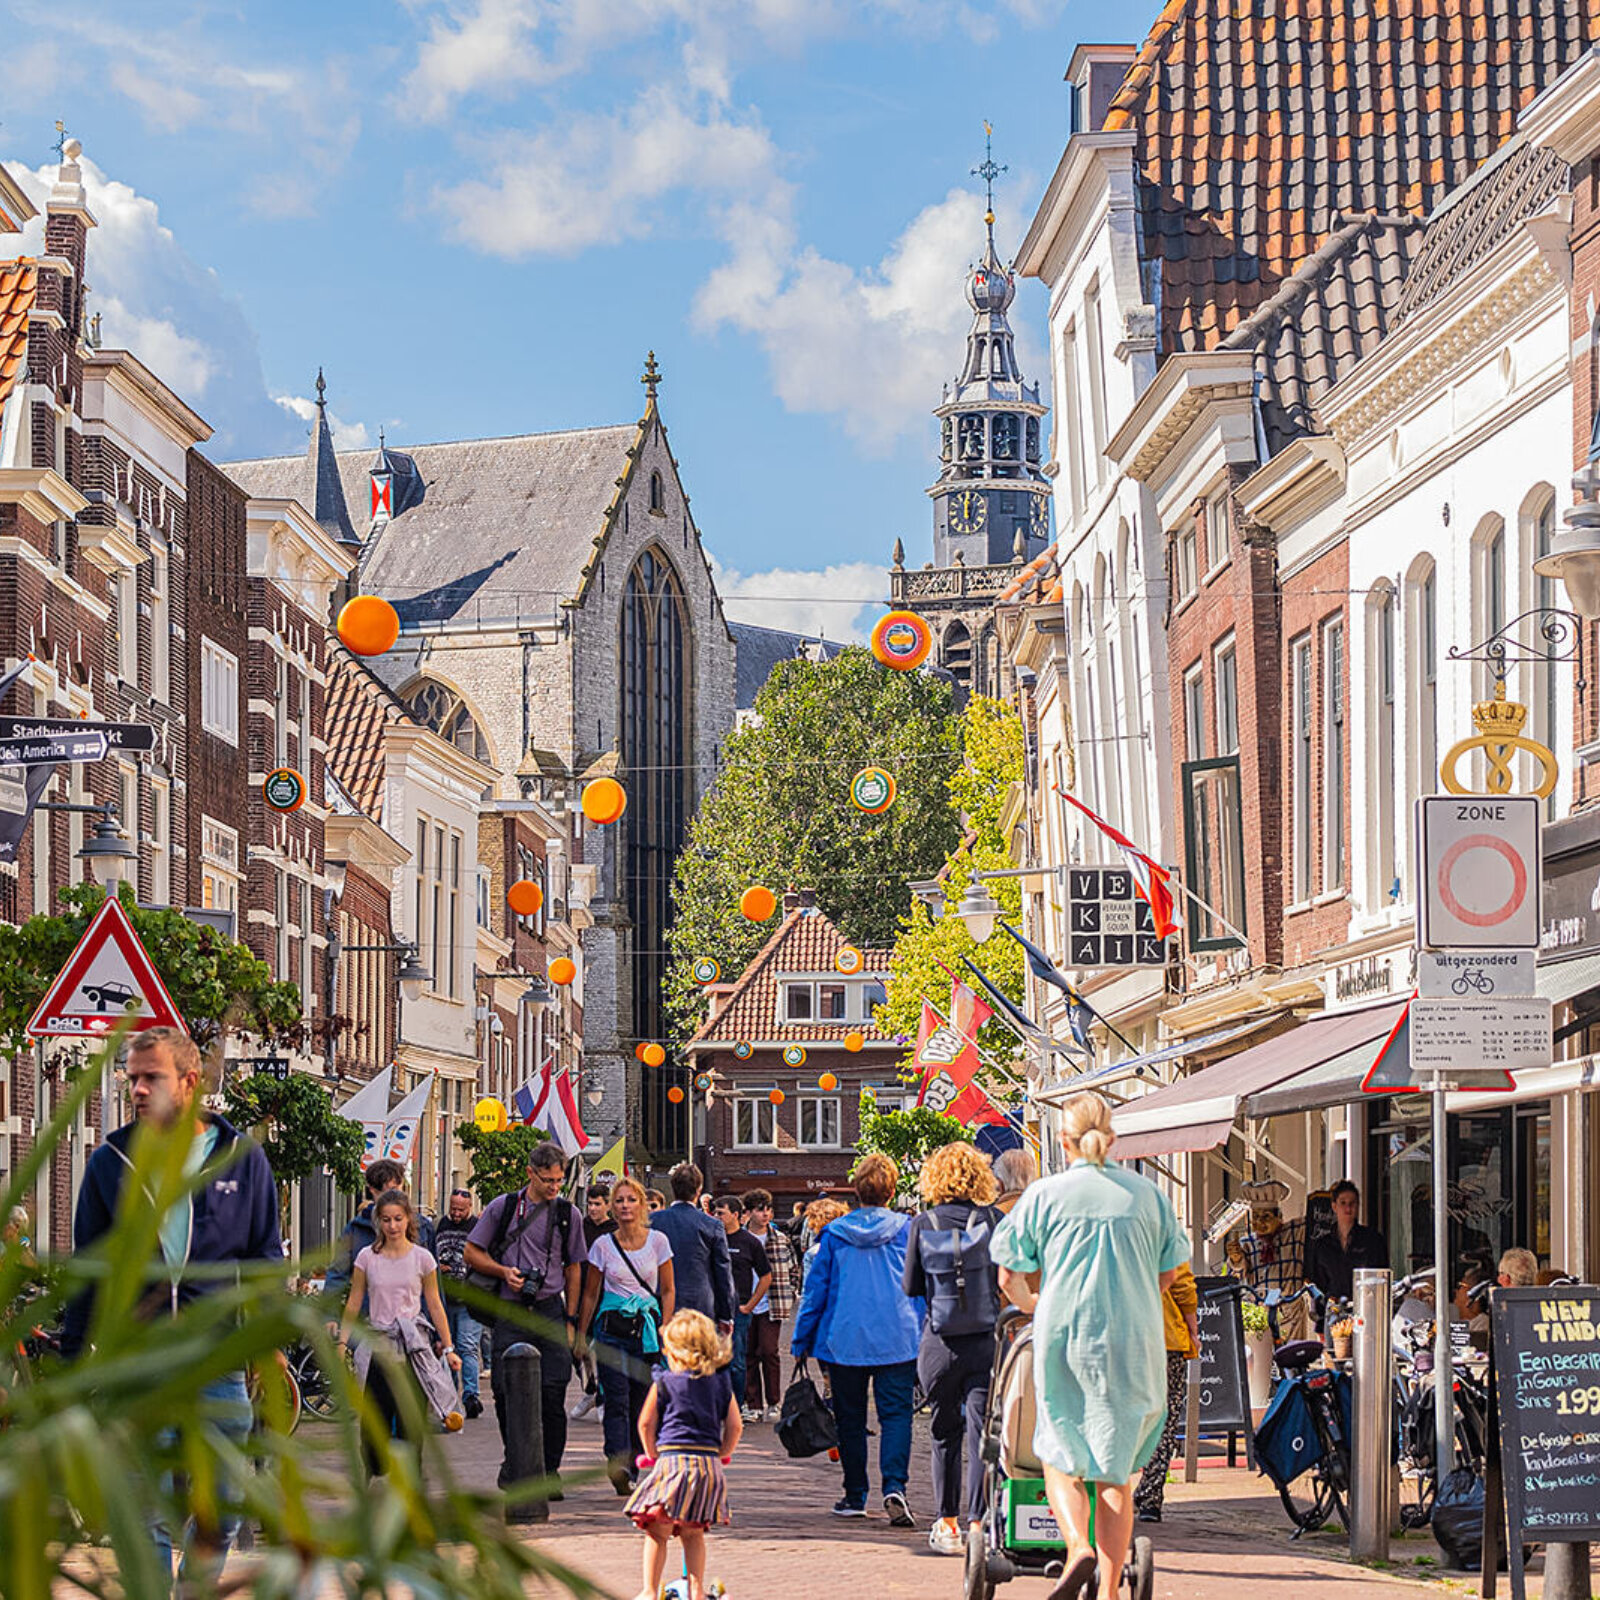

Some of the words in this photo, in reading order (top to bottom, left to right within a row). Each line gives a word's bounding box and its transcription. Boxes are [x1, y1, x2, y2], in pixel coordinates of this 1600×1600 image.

[23, 743, 66, 758] Amerika
[1456, 806, 1506, 821] ZONE
[1436, 955, 1518, 970] uitgezonderd
[256, 1062, 287, 1070] VAN
[1539, 1300, 1591, 1322] NEW
[1518, 1351, 1553, 1373] Een
